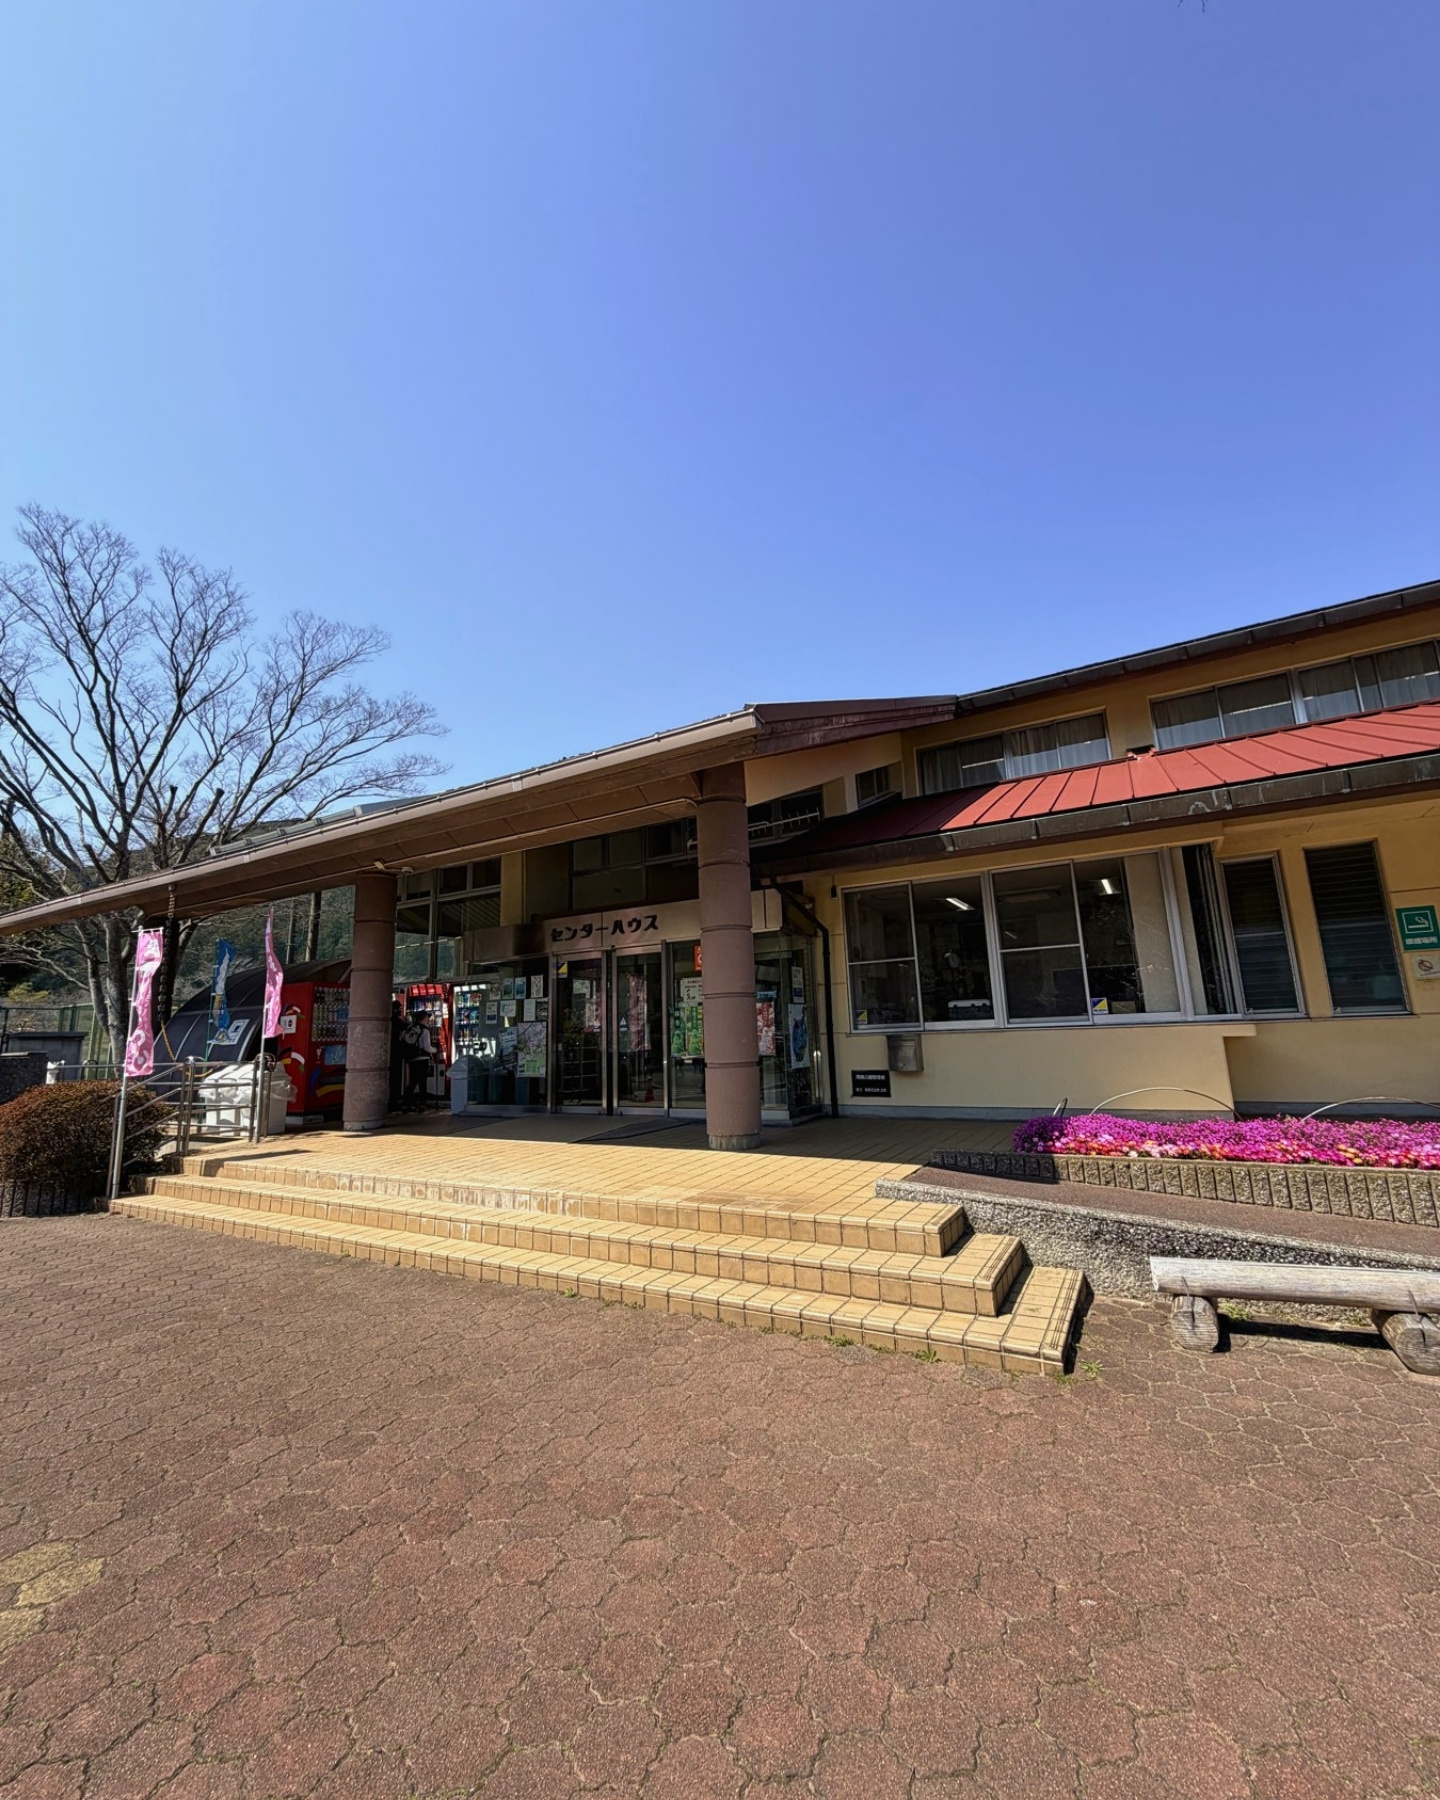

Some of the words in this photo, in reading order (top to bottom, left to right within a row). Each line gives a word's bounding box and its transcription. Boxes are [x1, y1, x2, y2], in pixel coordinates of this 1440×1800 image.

[550, 914, 659, 942] センターハウス
